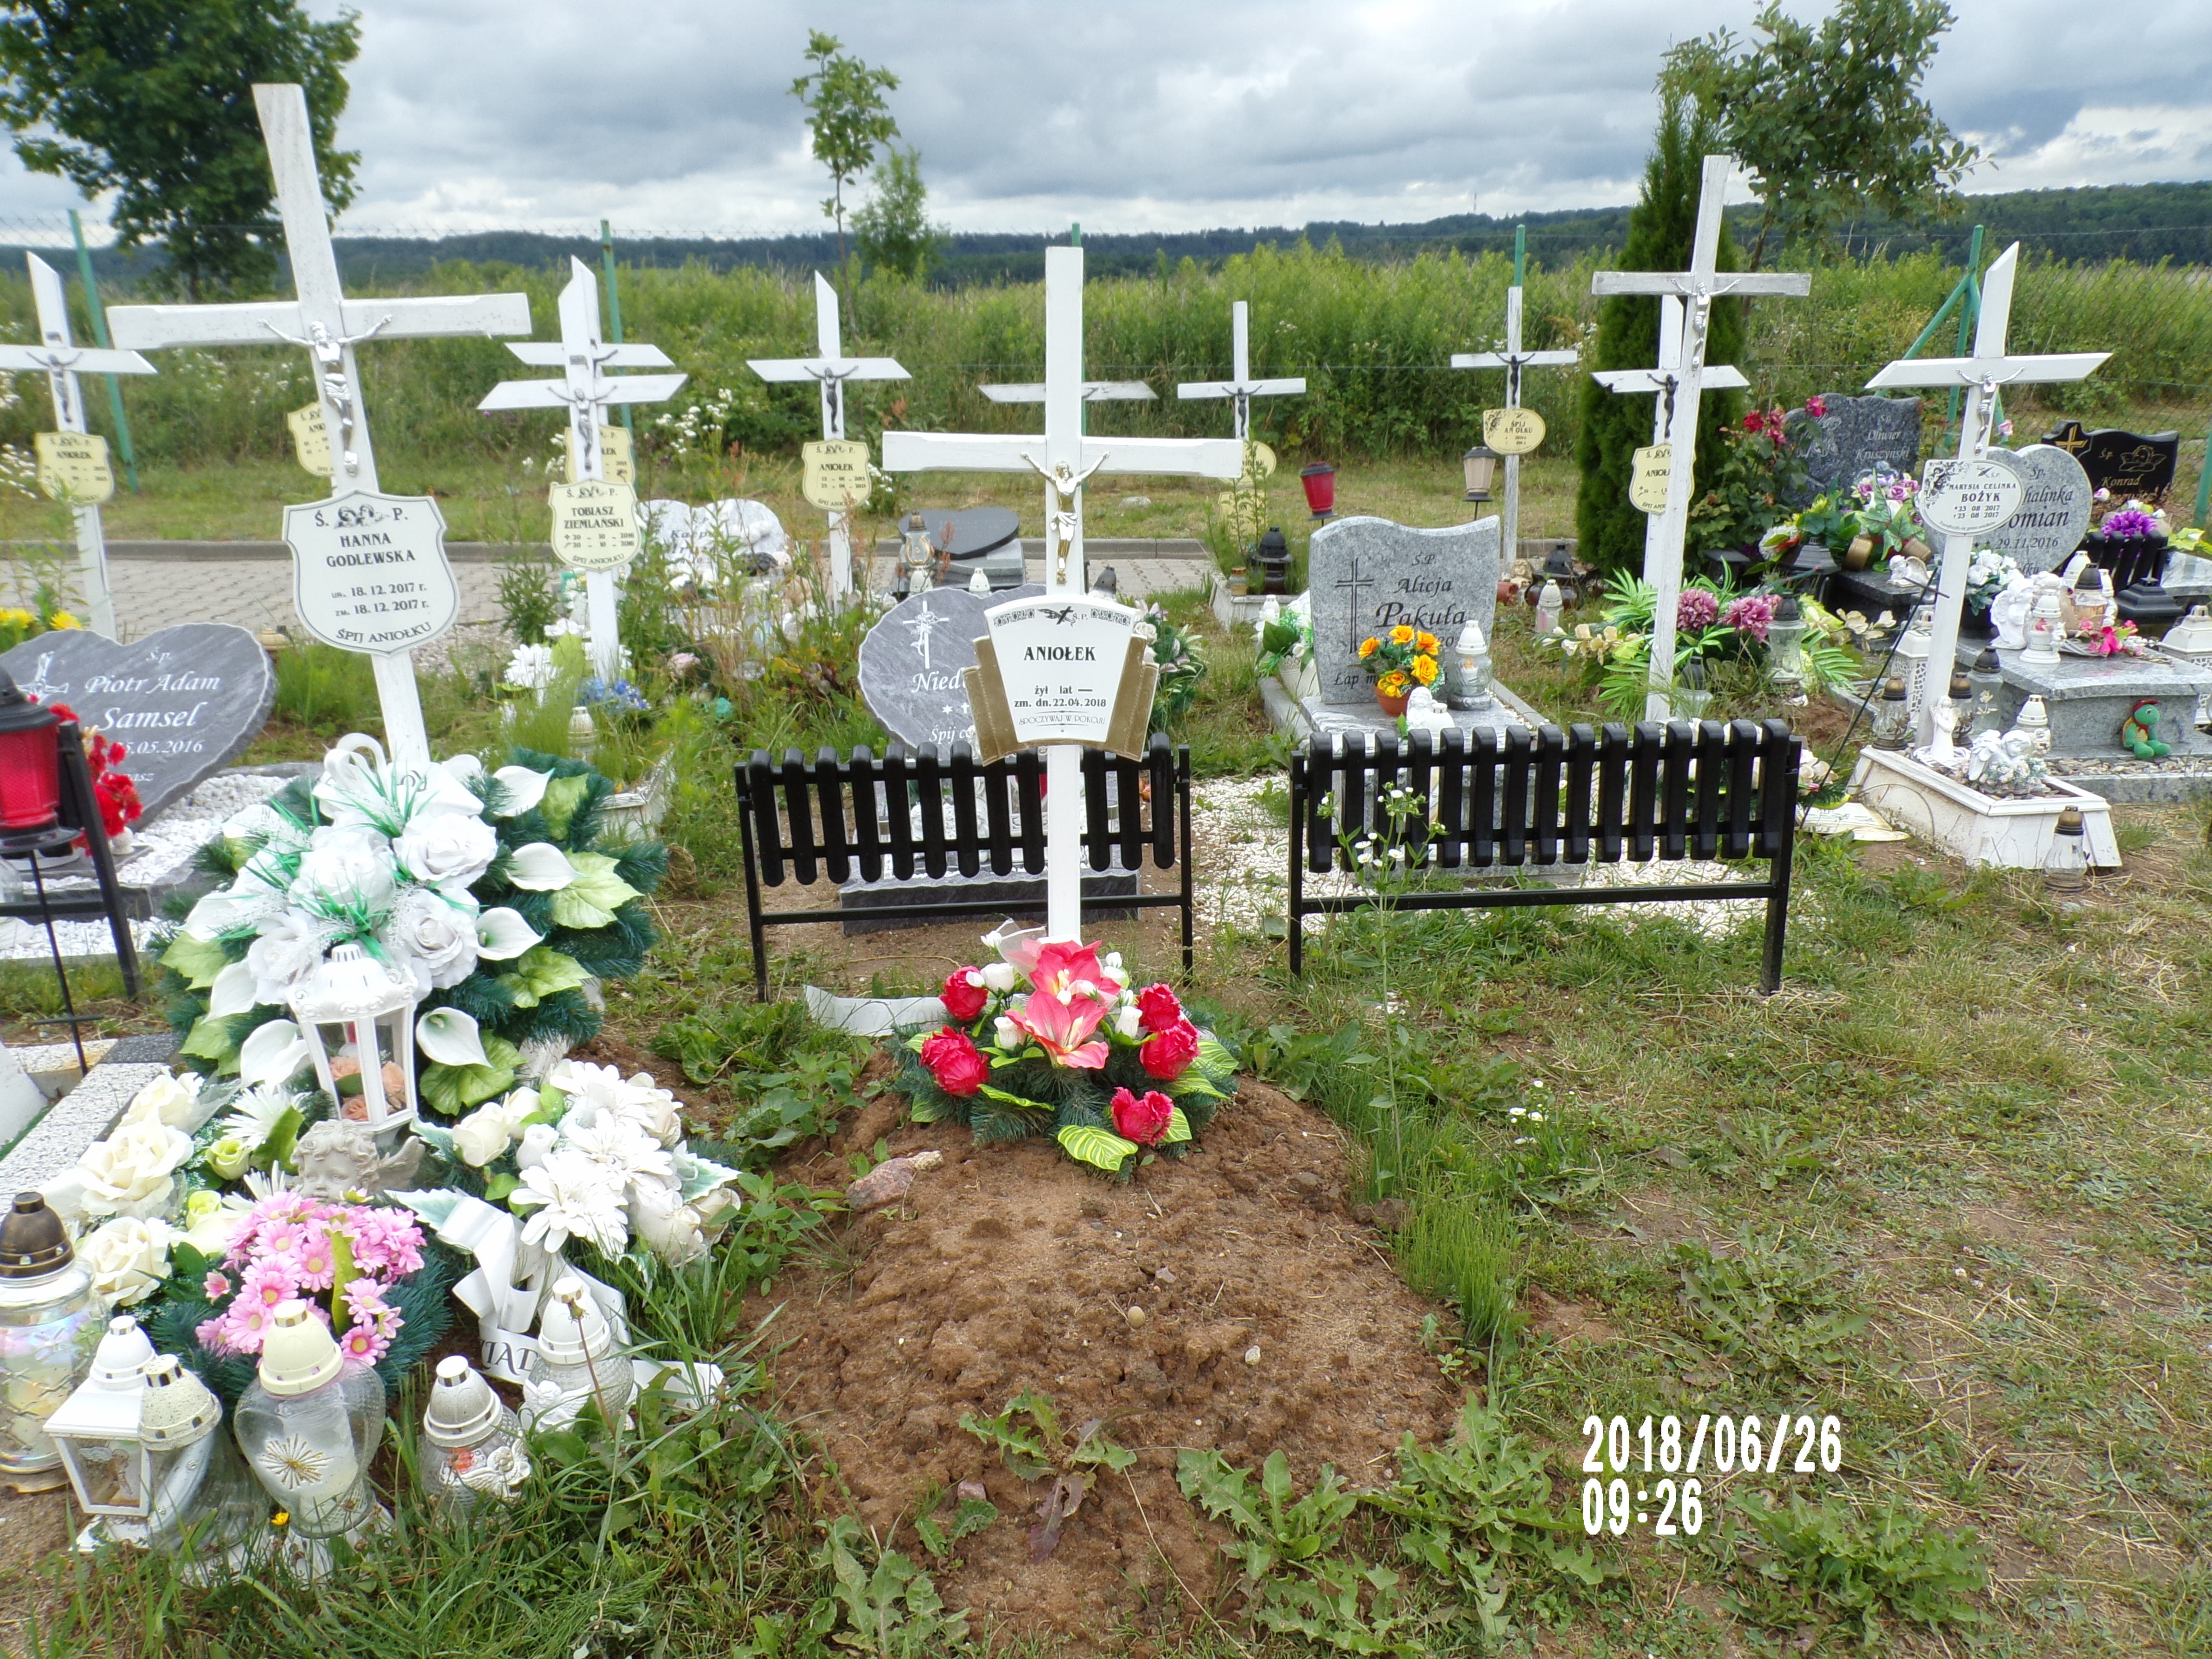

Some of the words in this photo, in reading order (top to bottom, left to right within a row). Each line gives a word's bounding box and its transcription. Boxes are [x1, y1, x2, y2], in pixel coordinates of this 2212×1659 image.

[309, 423, 326, 433] ANIO
[2101, 473, 2145, 489] Konrad
[1960, 490, 2001, 503] BOŻYK
[2022, 484, 2074, 505] halinka
[315, 510, 329, 527] Ś.
[392, 507, 408, 522] P.
[571, 506, 614, 517] TOBIASZ
[2001, 505, 2070, 529] omian
[340, 532, 392, 548] HANNA
[326, 549, 416, 567] GODLEWSKA
[351, 587, 367, 597] 18.
[370, 585, 386, 596] 12.
[390, 582, 415, 594] 2017
[1393, 576, 1454, 598] Alicja
[354, 605, 371, 615] 18.
[374, 602, 390, 613] 12.
[394, 599, 418, 611] 2017
[1374, 601, 1467, 630] Pakuła
[336, 628, 364, 644] ŚPIJ
[368, 622, 432, 643] ANIOŁKU
[1023, 646, 1096, 661] ANIOŁEK
[85, 675, 148, 694] Piotr
[145, 671, 221, 694] Adam
[1333, 671, 1359, 690] Łap
[1034, 685, 1048, 697] żył
[1059, 685, 1073, 695] lat
[1014, 699, 1032, 708] zm.
[96, 702, 208, 731] Samsel
[1018, 715, 1063, 725] SPOCZYWAJ
[1065, 714, 1072, 722] W
[1074, 715, 1106, 725] POKOJU
[928, 725, 957, 744] Śpij
[125, 739, 206, 755] 5.05.2016
